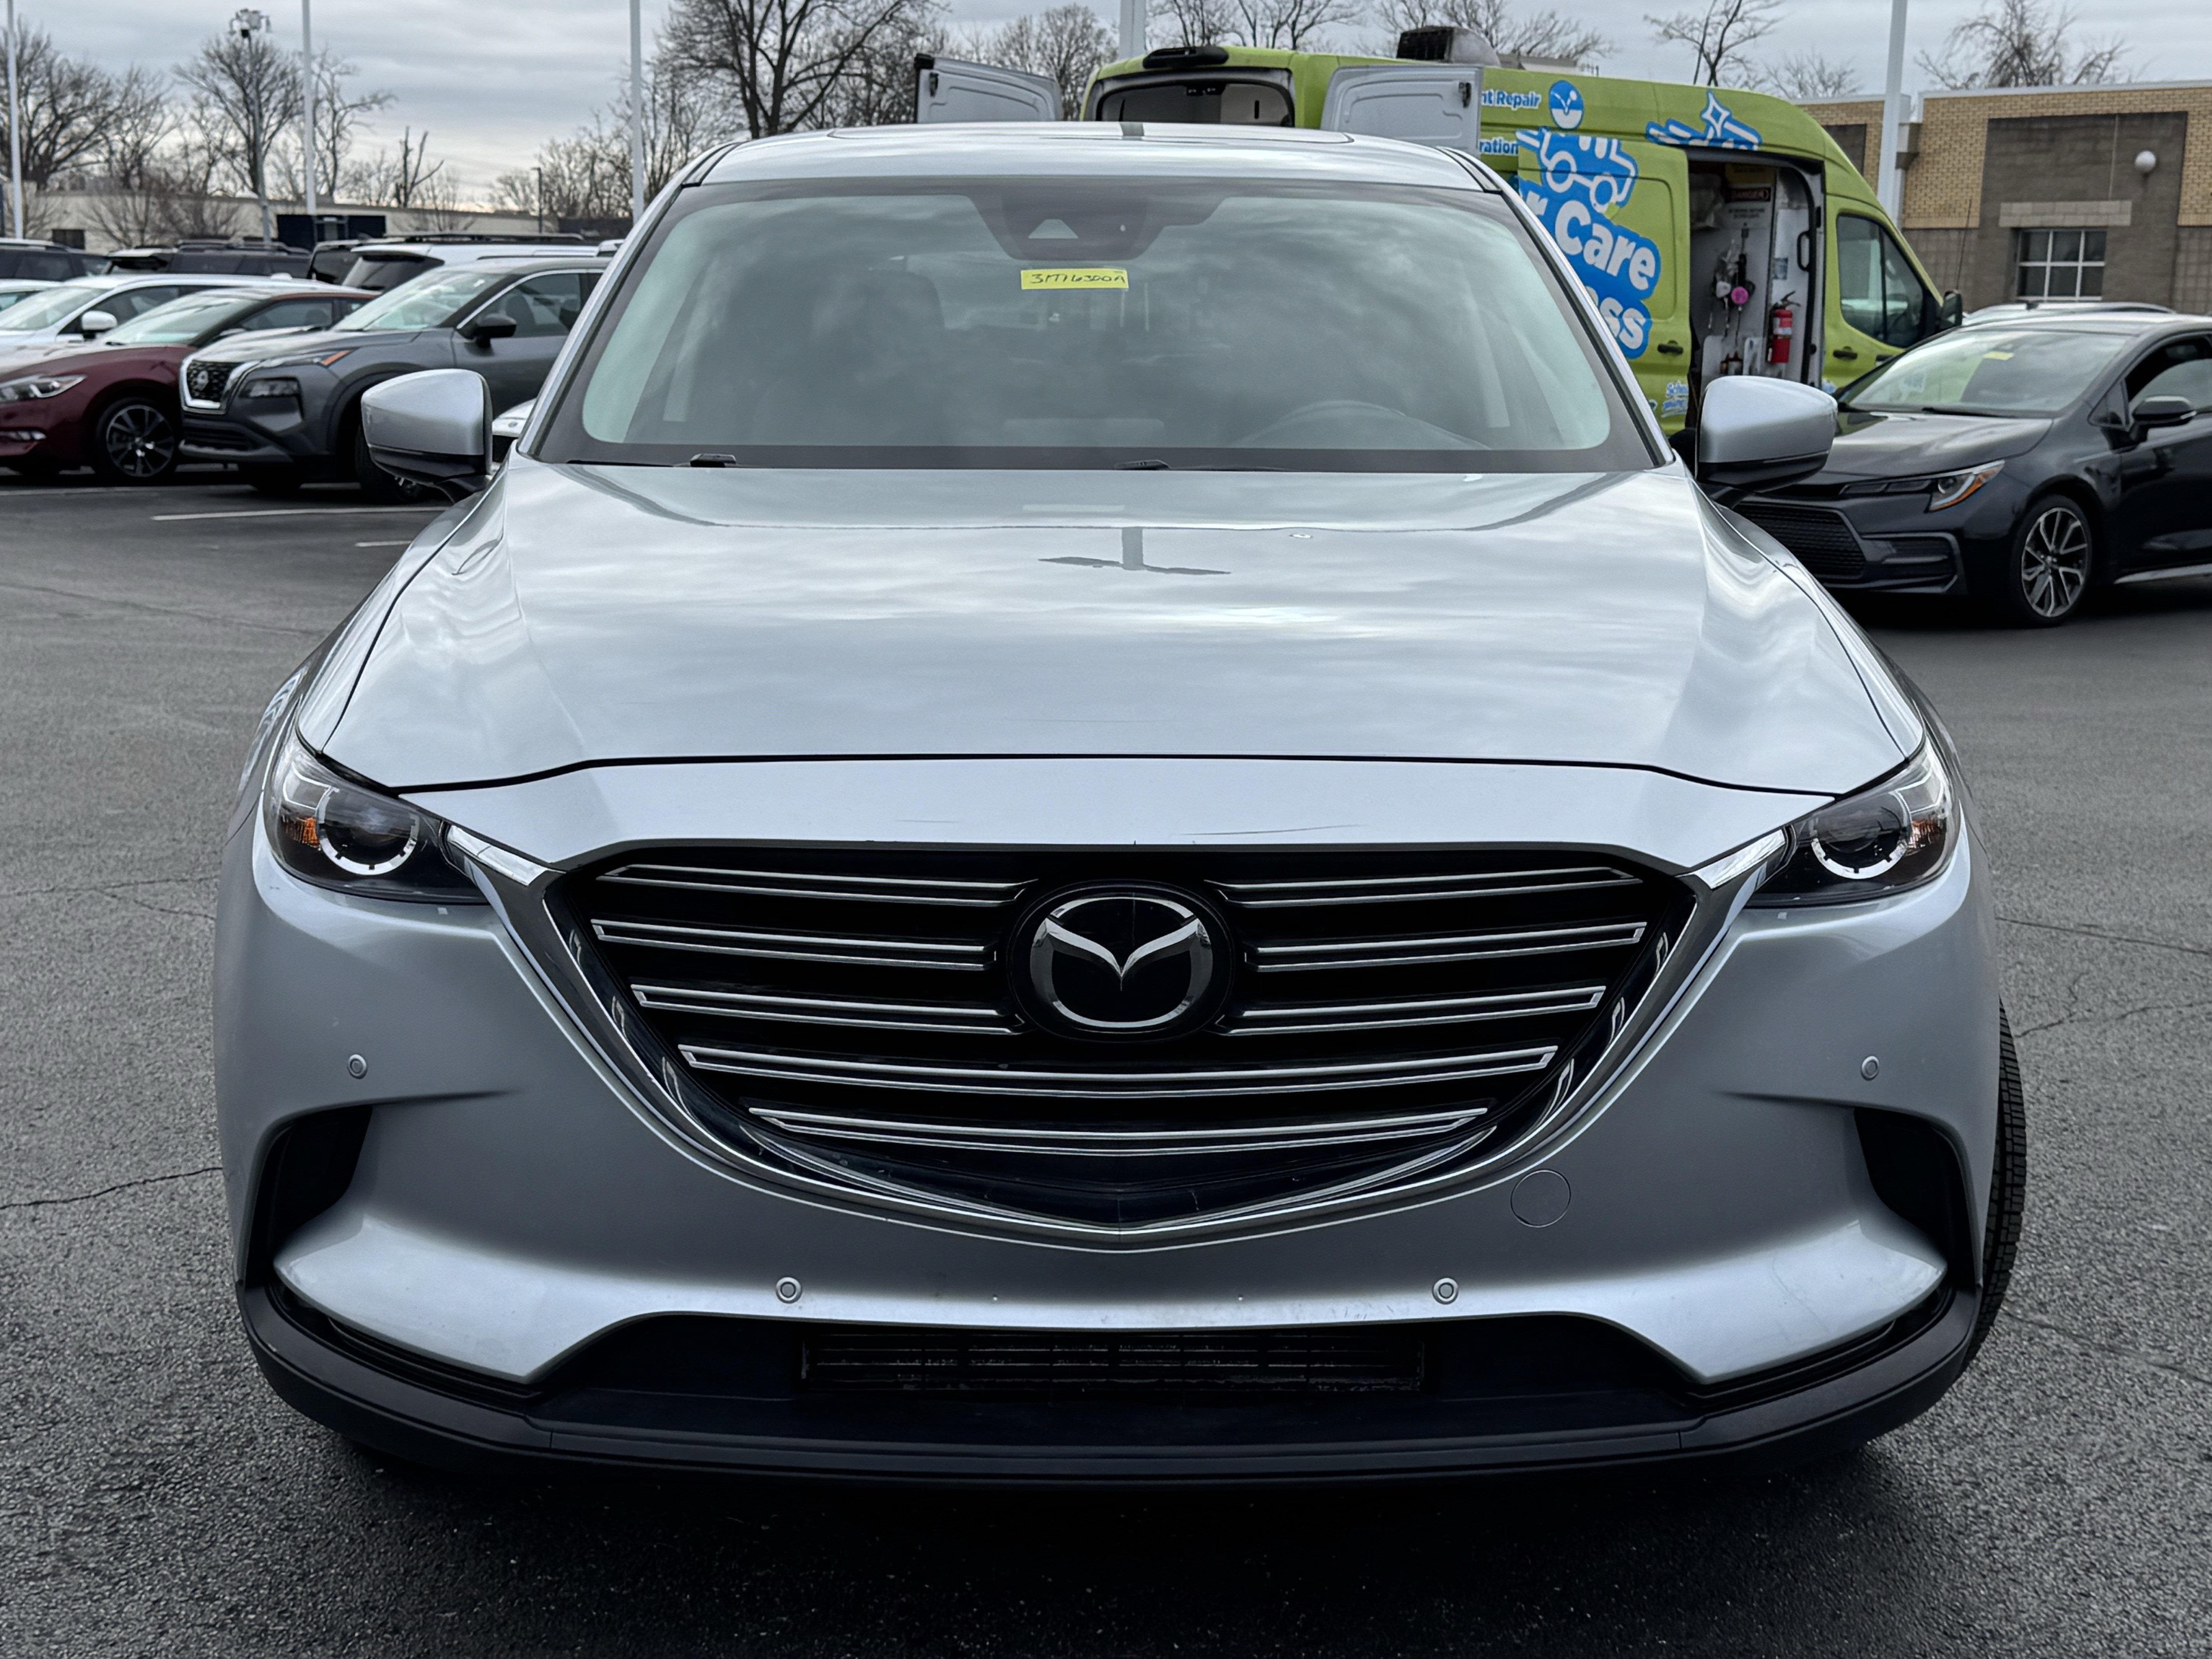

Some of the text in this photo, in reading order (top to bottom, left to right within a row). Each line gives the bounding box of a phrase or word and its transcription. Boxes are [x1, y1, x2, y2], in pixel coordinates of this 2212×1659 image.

[1496, 91, 1540, 109] Repair
[1479, 138, 1518, 154] ration
[1555, 200, 1656, 290] Care
